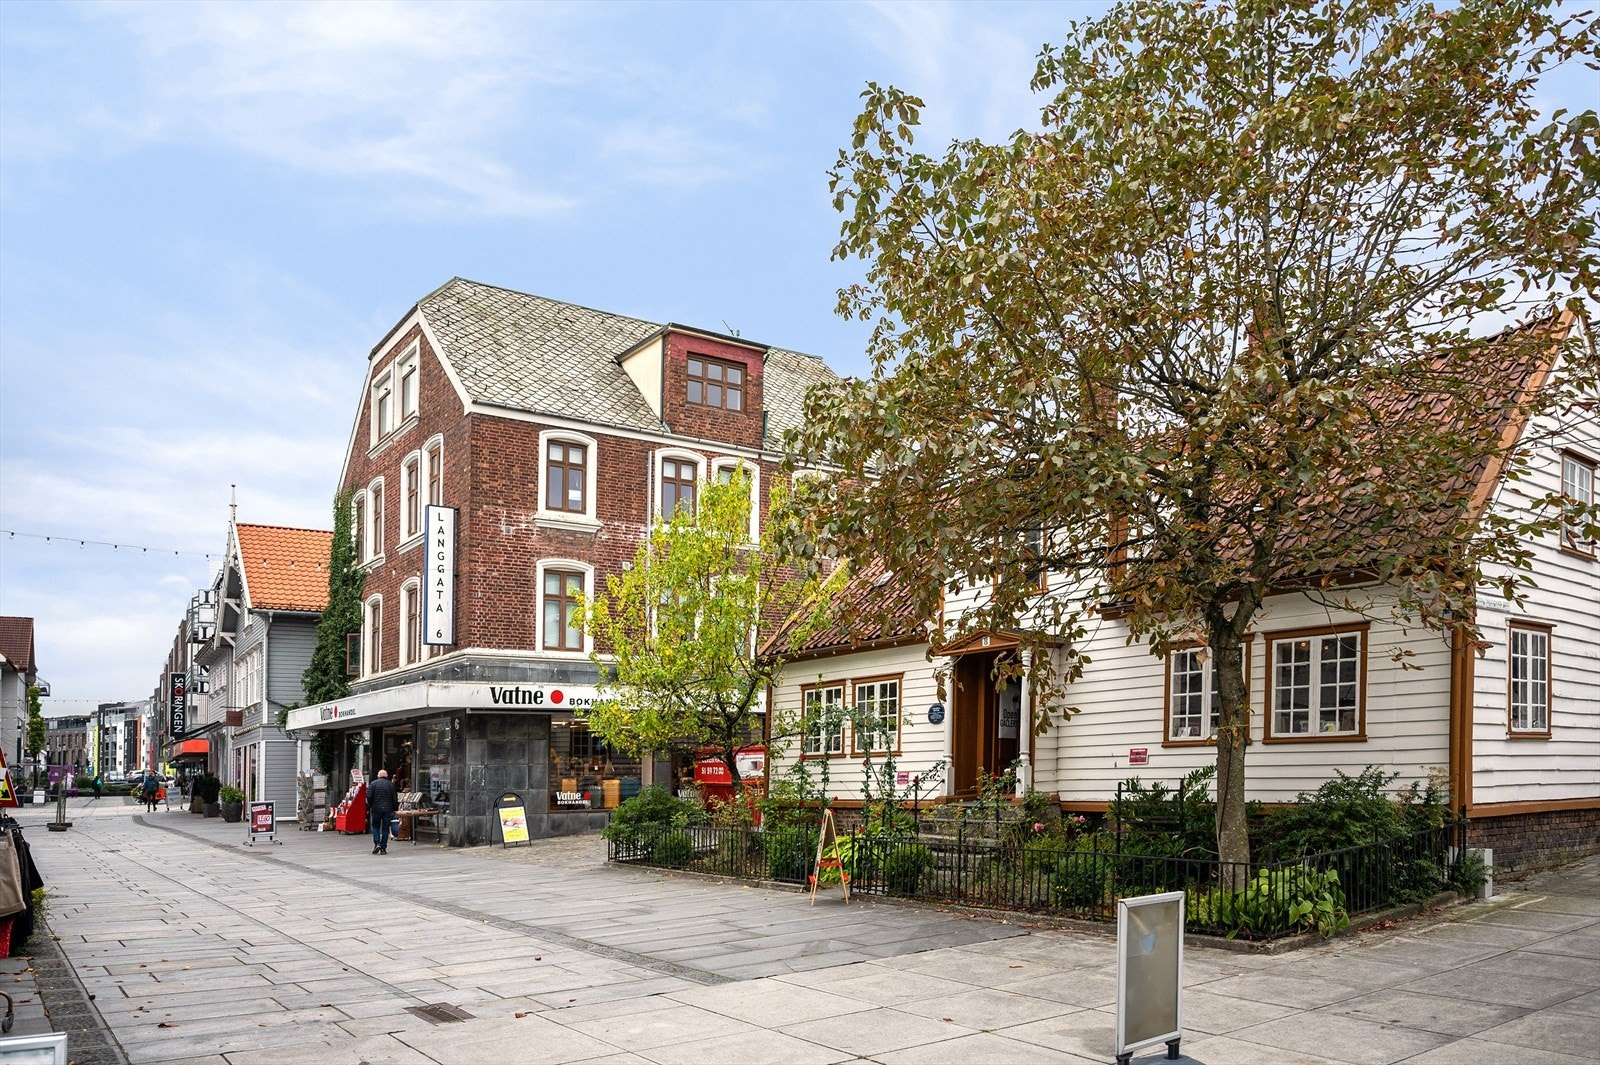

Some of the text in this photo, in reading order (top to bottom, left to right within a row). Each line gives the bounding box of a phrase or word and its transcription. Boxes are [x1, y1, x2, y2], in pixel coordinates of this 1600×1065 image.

[436, 512, 445, 638] LANGGATA 6
[489, 686, 544, 705] Vatne
[320, 705, 333, 721] Vatne
[1003, 709, 1018, 720] Open
[556, 791, 581, 801] Vatne
